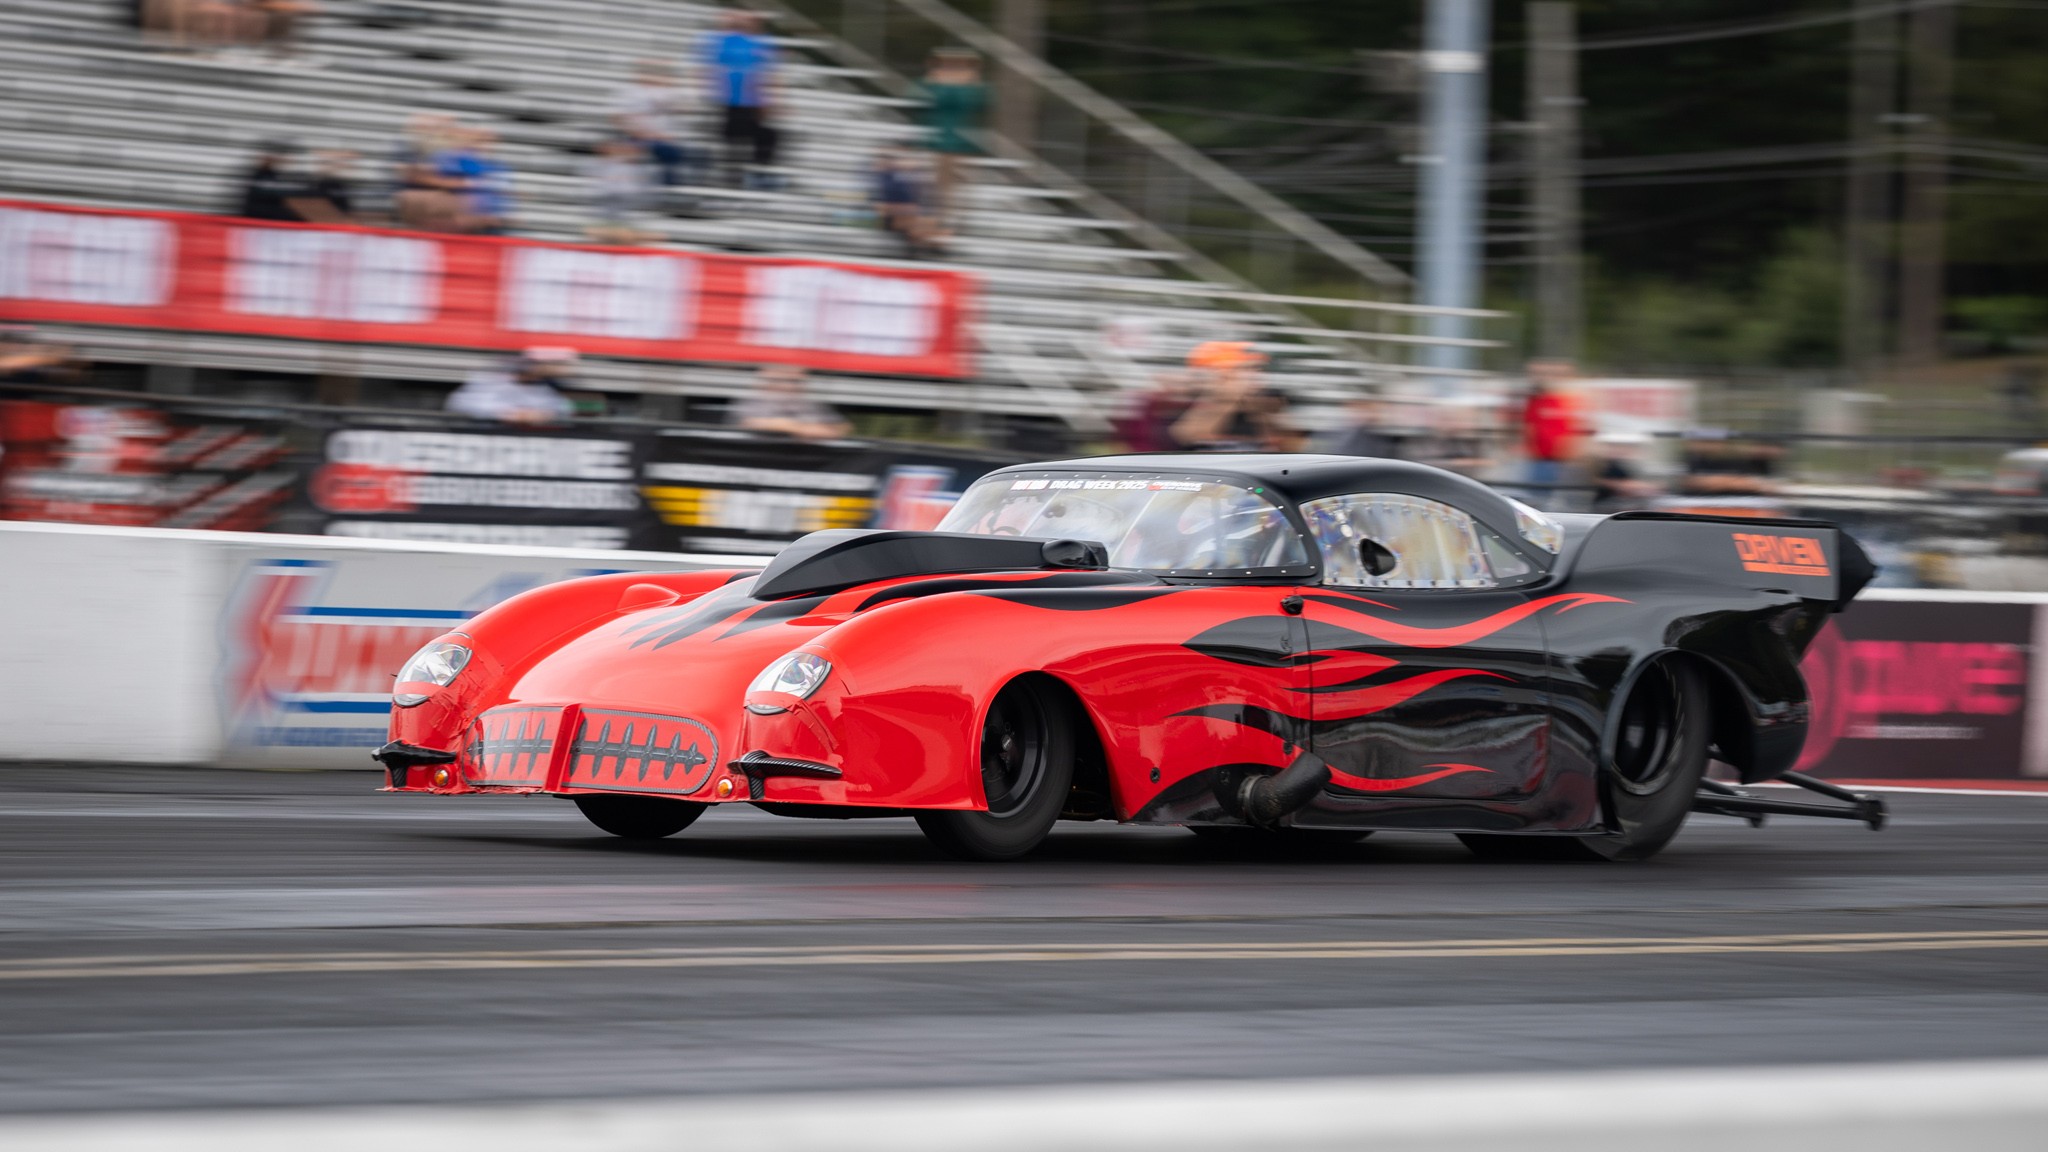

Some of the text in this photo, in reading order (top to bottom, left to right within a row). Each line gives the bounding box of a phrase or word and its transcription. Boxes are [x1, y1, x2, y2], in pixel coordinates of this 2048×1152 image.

[1049, 480, 1084, 489] DRAG
[1083, 480, 1119, 490] WEEK
[1116, 480, 1149, 490] 2025
[1731, 532, 1828, 566] DRIVEN
